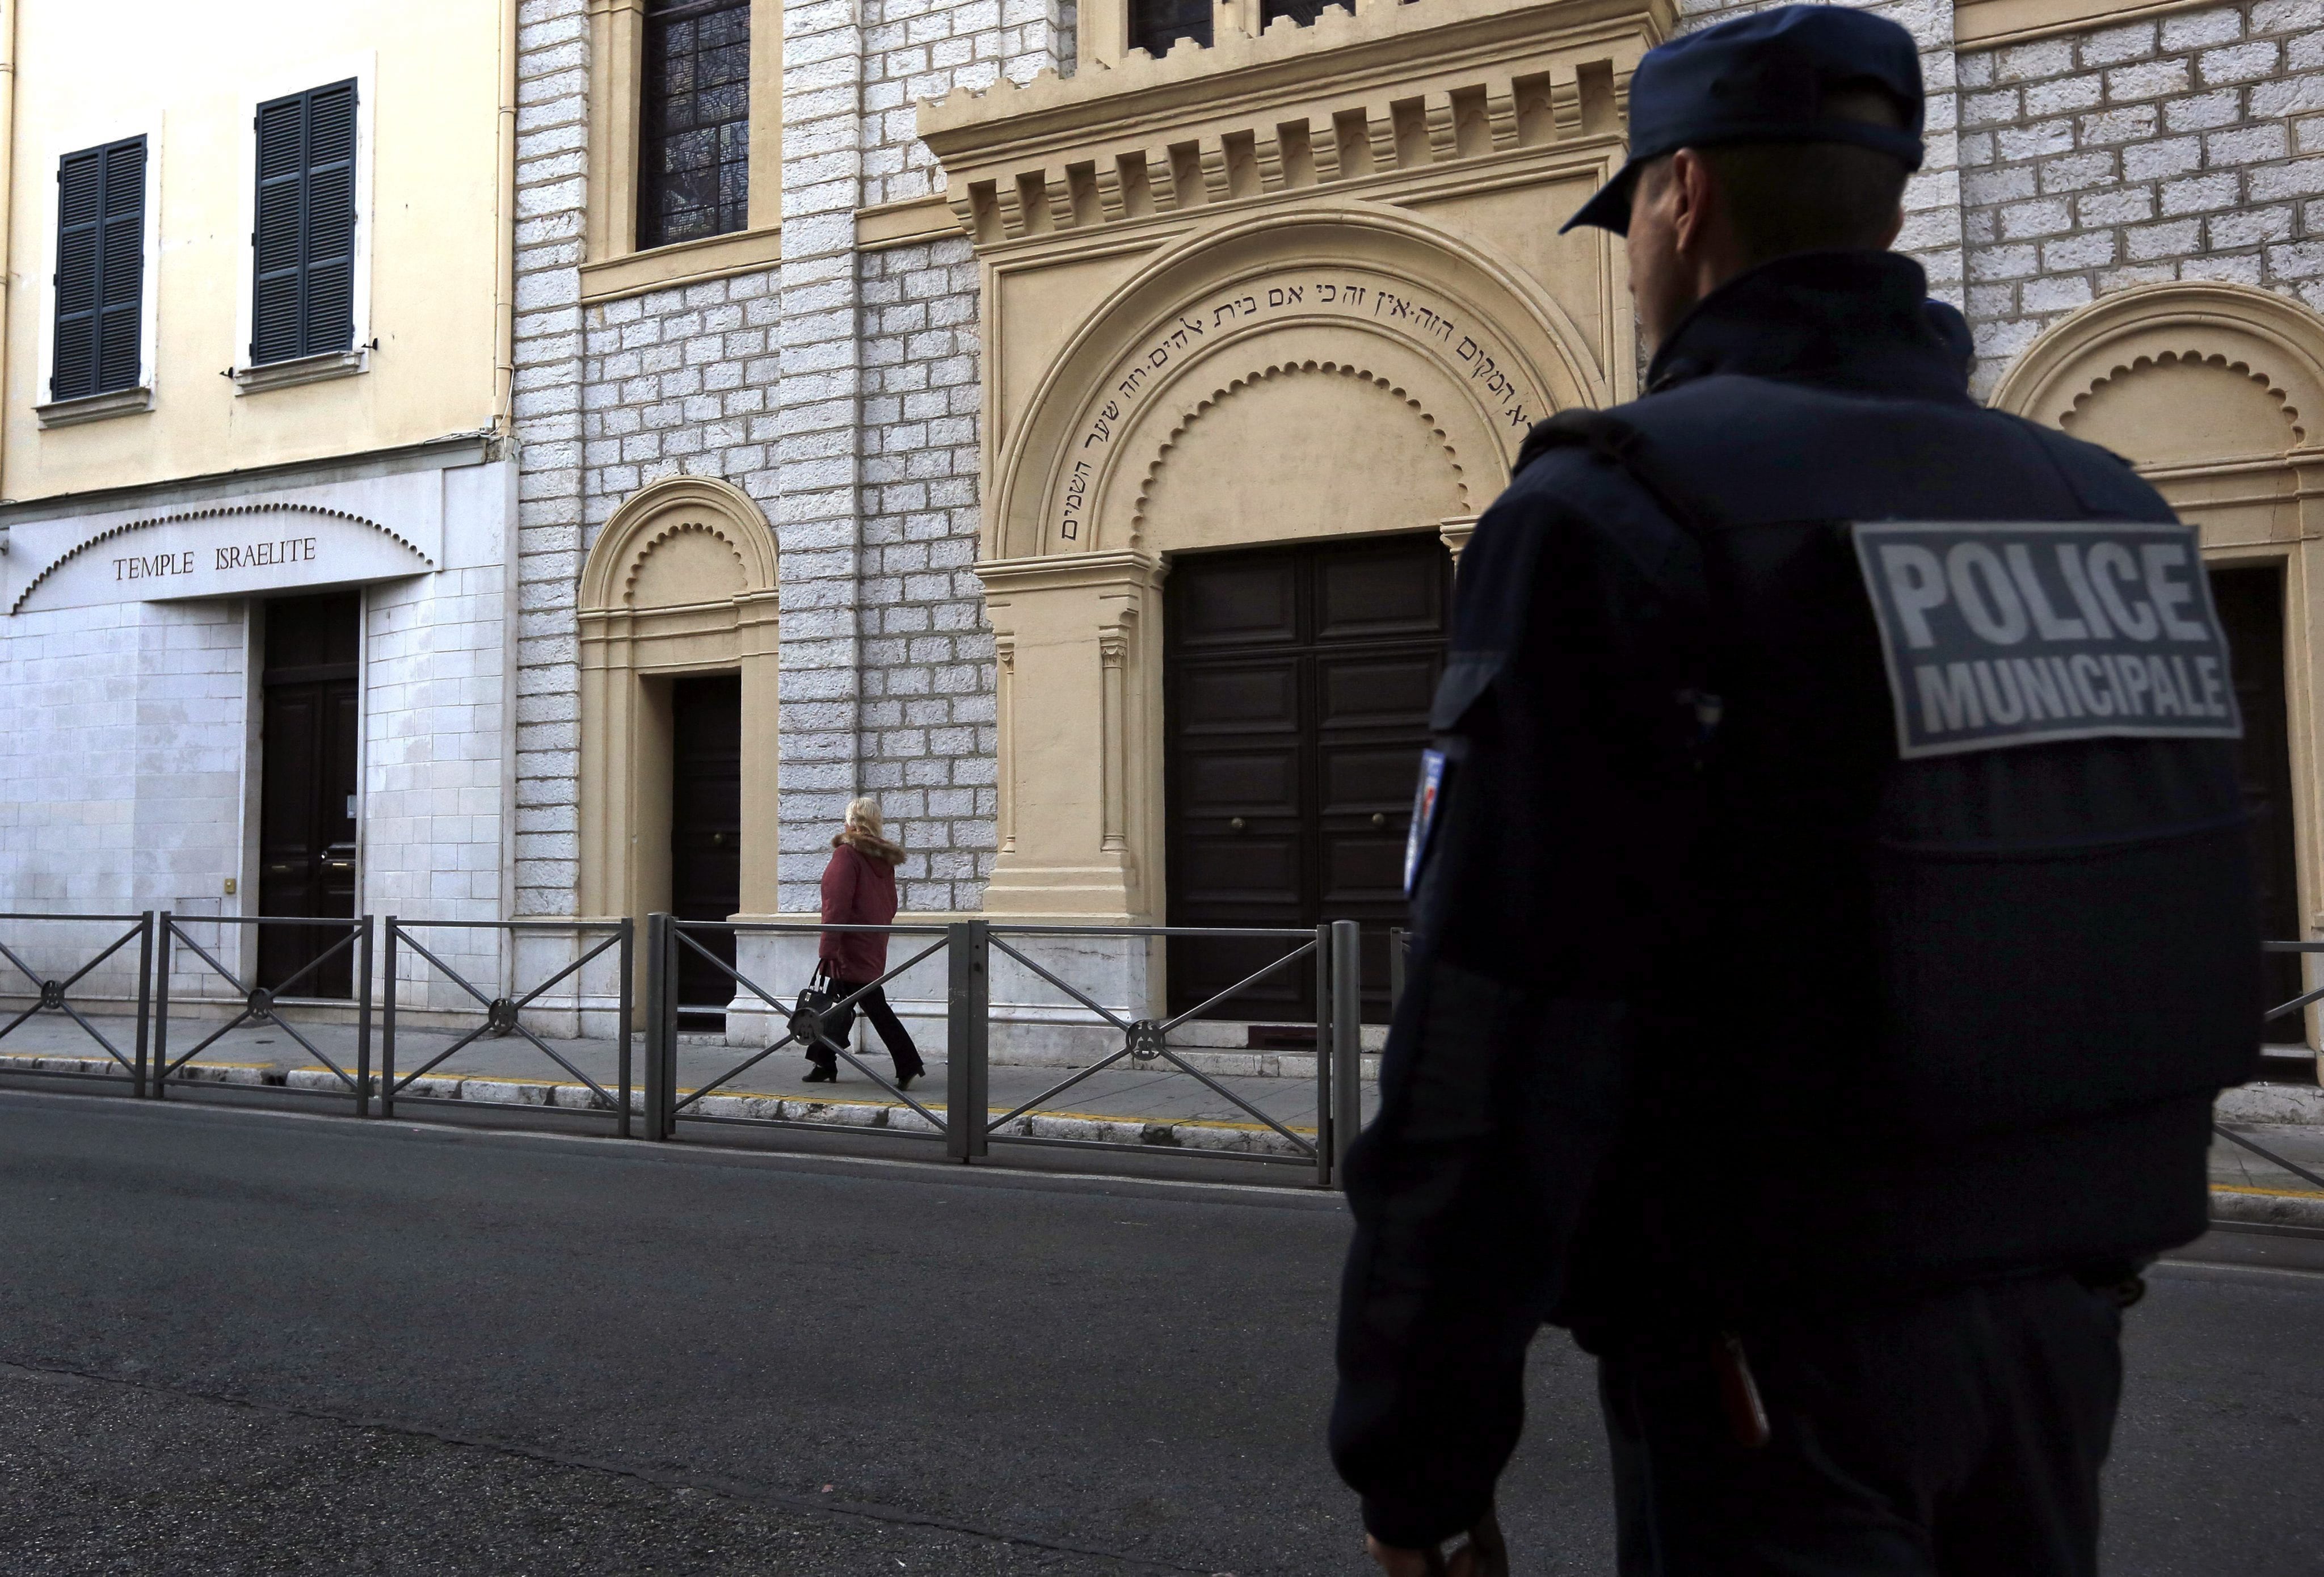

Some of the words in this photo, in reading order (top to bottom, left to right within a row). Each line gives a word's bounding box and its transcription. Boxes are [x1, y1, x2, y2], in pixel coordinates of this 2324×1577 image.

[1213, 296, 1257, 328] בית
[1268, 285, 1303, 308] אם
[1316, 284, 1336, 302] כי
[1342, 285, 1366, 305] זה
[1375, 292, 1410, 318] אין
[1119, 368, 1147, 398] וזה
[1456, 336, 1515, 405] המקום
[1084, 400, 1119, 448] שער
[1061, 461, 1092, 541] השמים
[113, 552, 195, 581] TEMPLE
[215, 537, 317, 570] ISRAELITE
[1879, 541, 2210, 649] POLICE
[1913, 653, 2226, 733] MUNICIPALE
